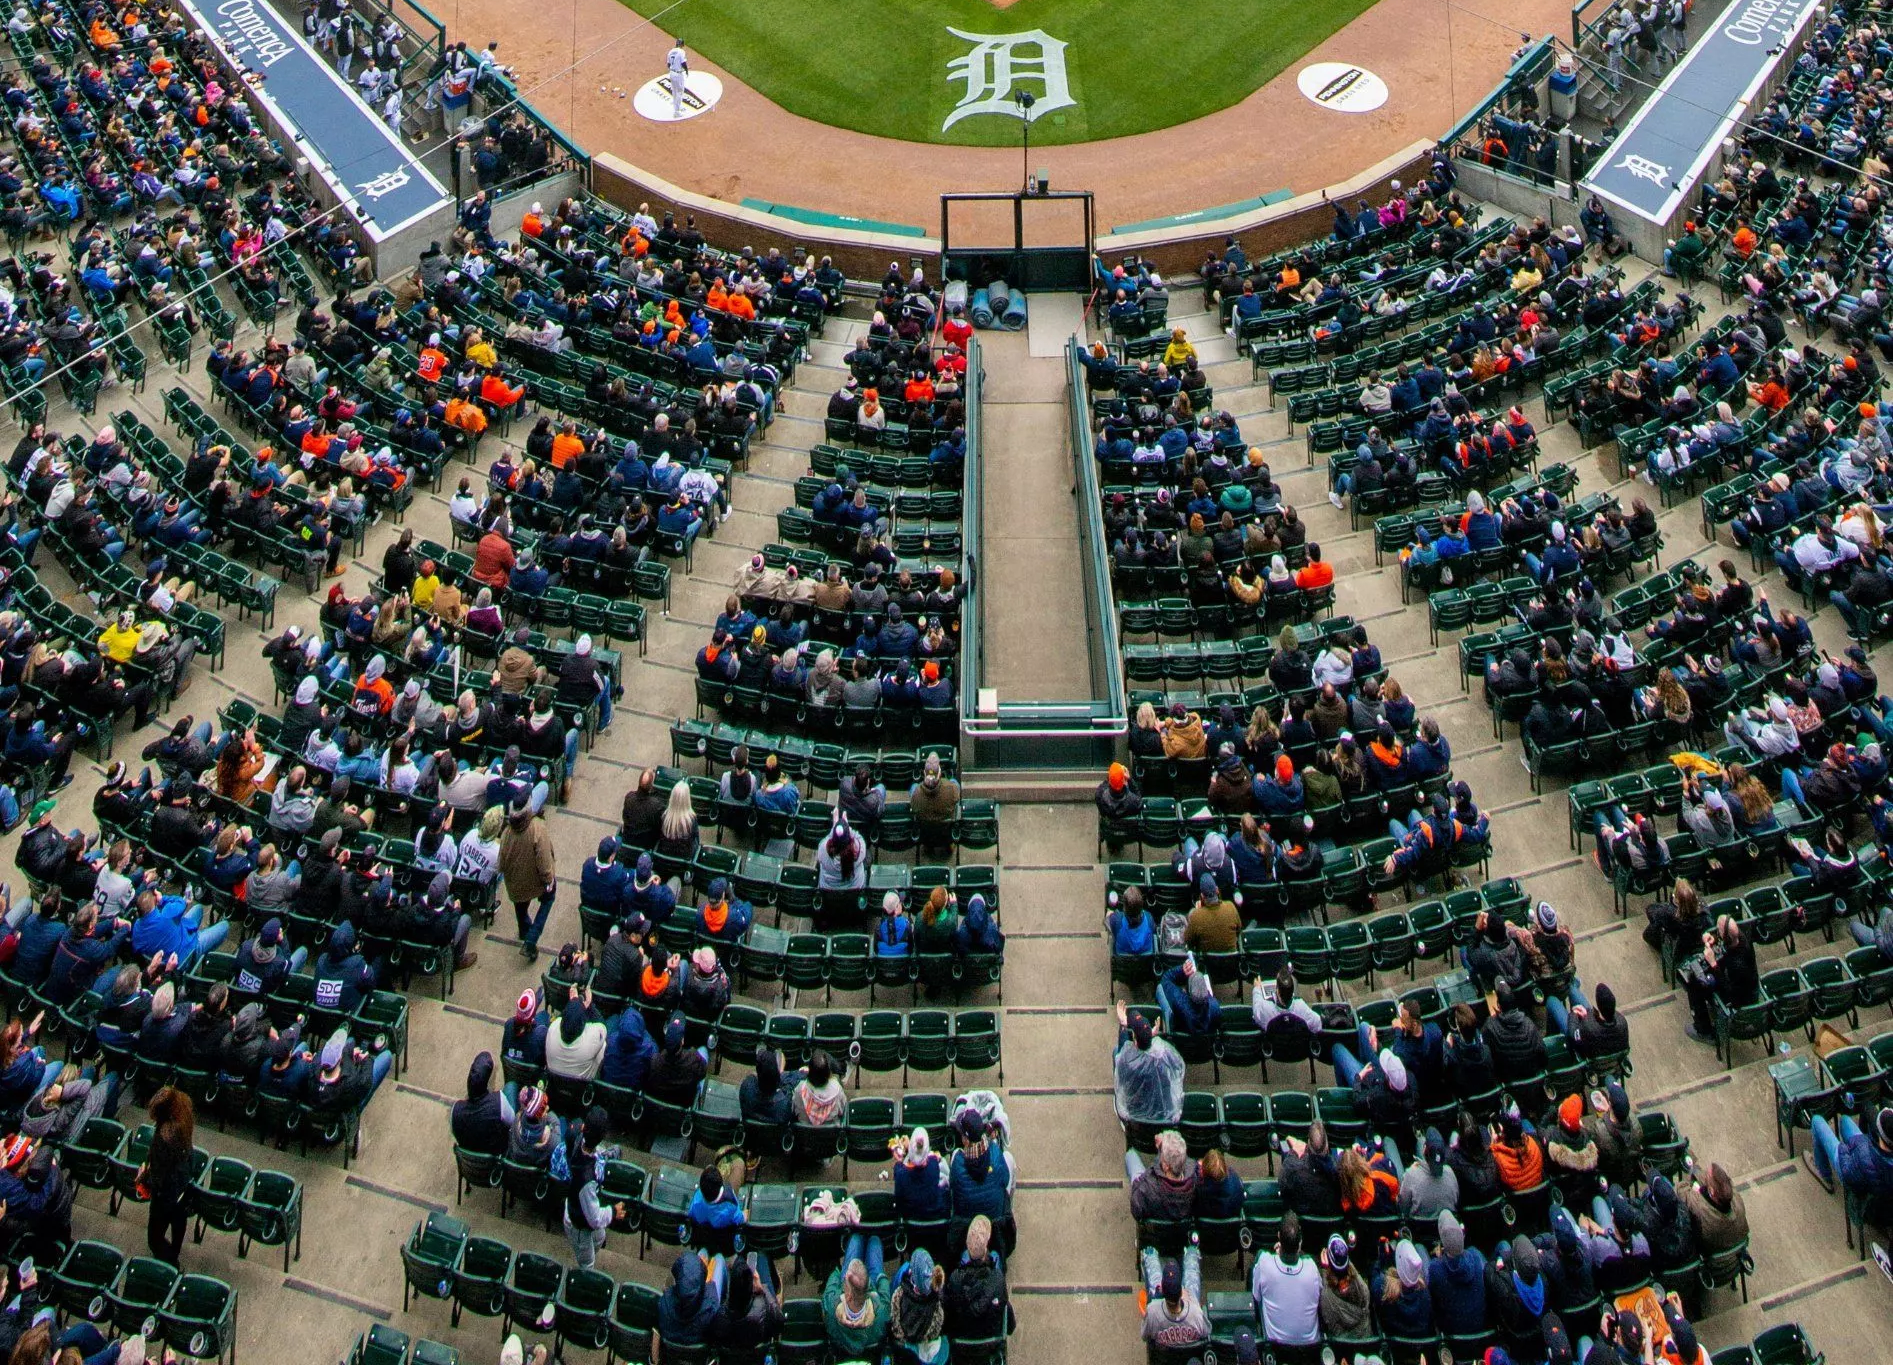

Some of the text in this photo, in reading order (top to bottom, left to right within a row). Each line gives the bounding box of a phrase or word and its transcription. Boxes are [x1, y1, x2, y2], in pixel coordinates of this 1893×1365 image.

[1768, 0, 1800, 32] PARK
[218, 21, 255, 58] PARK
[671, 56, 675, 65] 7
[420, 356, 434, 372] 23
[356, 699, 377, 714] Tigers
[464, 843, 490, 869] CABRERA
[240, 972, 261, 989] SDC
[317, 982, 342, 994] SDC
